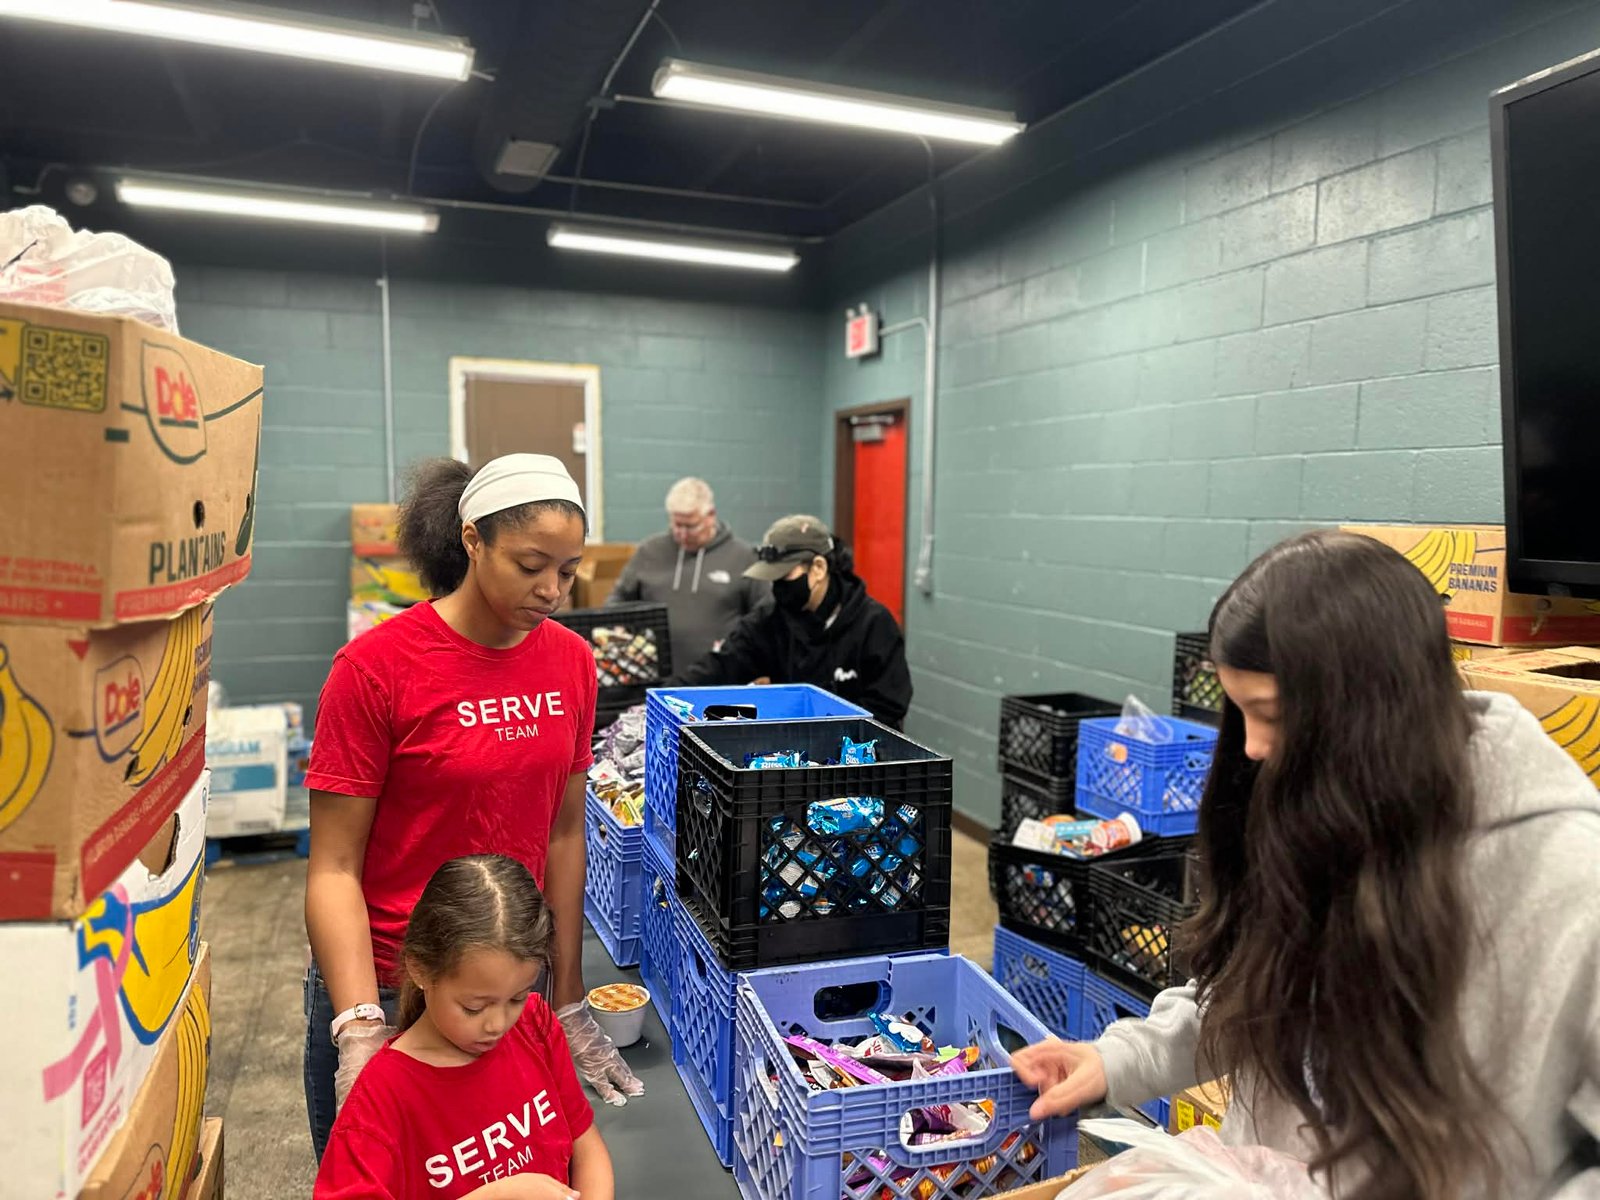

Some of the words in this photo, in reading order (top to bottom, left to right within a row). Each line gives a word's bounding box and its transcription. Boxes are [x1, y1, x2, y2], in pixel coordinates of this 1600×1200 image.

[154, 367, 198, 422] Dole
[1448, 577, 1498, 592] BANANAS
[1450, 563, 1498, 577] PREMIUM
[105, 671, 141, 727] Dole
[457, 691, 565, 727] SERVE
[494, 723, 539, 741] TEAM
[425, 1089, 557, 1188] SERVE
[478, 1145, 533, 1185] TEAM
